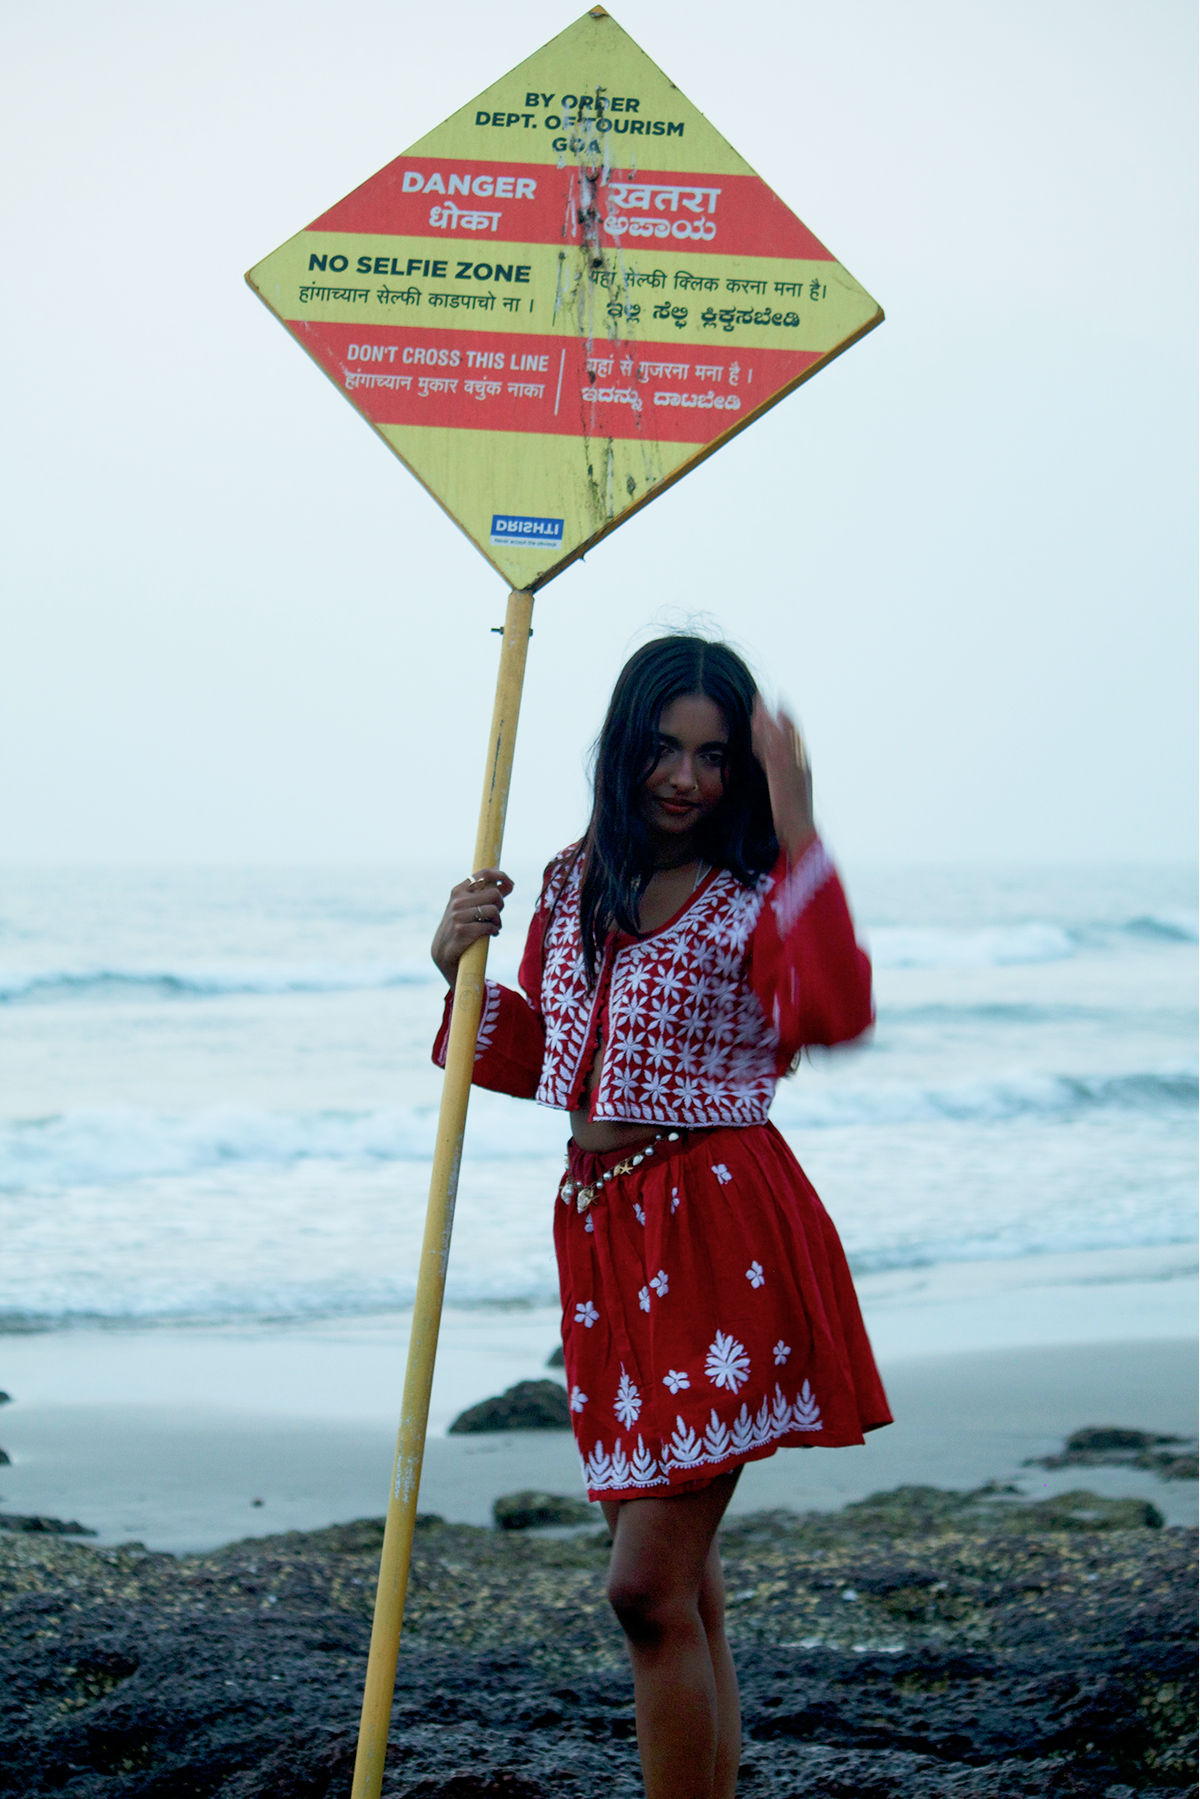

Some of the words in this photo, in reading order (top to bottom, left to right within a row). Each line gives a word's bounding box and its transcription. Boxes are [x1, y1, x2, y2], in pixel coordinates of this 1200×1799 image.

[525, 92, 555, 108] BY
[561, 94, 640, 113] ORDER
[475, 111, 537, 129] DEPT.
[545, 115, 576, 131] OF
[582, 117, 685, 137] TOURISM
[552, 137, 602, 154] GOA
[402, 171, 537, 200] DANGER
[607, 182, 722, 214] खतरा
[429, 201, 502, 232] धोका
[603, 215, 717, 241] ಅಪಾಯ
[308, 253, 349, 272] NO
[356, 256, 448, 278] SELFIE
[454, 261, 531, 283] ZONE
[624, 267, 667, 290] सेल्फी
[674, 270, 720, 292] क्लिक
[726, 278, 768, 296] करना
[774, 281, 804, 298] मना
[299, 281, 370, 304] हांगाच्यान
[377, 284, 422, 306] सेल्फी
[428, 291, 496, 311] काडपाचो
[502, 297, 521, 313] ना
[607, 301, 641, 324] ಇಲ್ಲಿ
[347, 344, 399, 363] DON'T
[402, 347, 461, 367] CROSS
[466, 350, 505, 370] THIS
[510, 354, 549, 372] LINE
[586, 354, 614, 378] यहां
[619, 354, 634, 377] से
[637, 361, 690, 384] गुजरना
[695, 364, 724, 381] मना
[729, 361, 741, 386] है
[345, 368, 413, 390] हांगाच्यान
[418, 376, 459, 398] मुकार
[464, 375, 503, 401] वचुंक
[507, 381, 545, 399] नाका
[581, 386, 643, 412] ಇದನ್ನು
